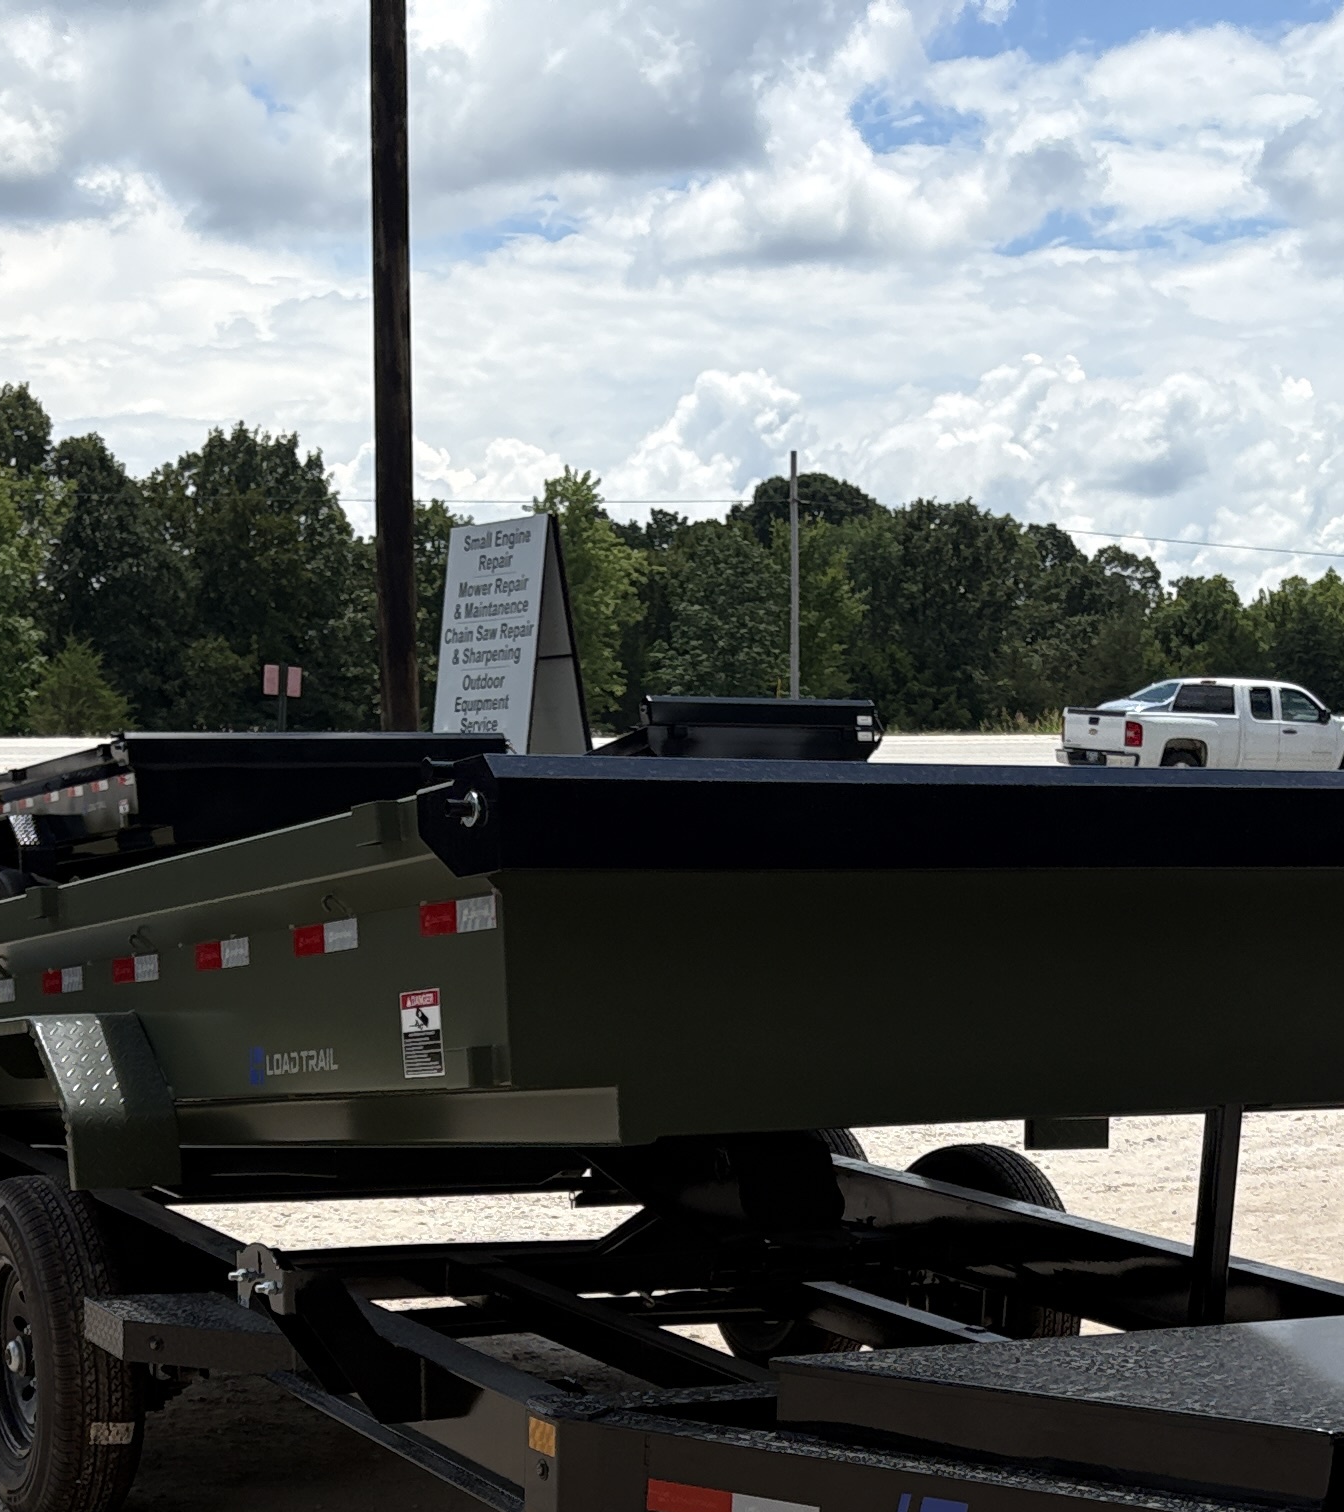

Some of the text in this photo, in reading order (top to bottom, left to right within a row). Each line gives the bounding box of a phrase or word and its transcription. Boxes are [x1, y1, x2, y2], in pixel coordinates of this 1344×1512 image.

[464, 528, 531, 552] Small Engine
[478, 551, 514, 573] Repair
[458, 573, 529, 598] Mower Repair
[454, 599, 529, 620] & Maintanence
[444, 620, 535, 645] Chain Saw Repair
[452, 644, 522, 667] & Sharpening
[462, 672, 505, 691] Outdoor
[454, 693, 510, 716] Equipment
[460, 716, 498, 734] Service
[265, 1047, 339, 1076] LOAD TRAIL
